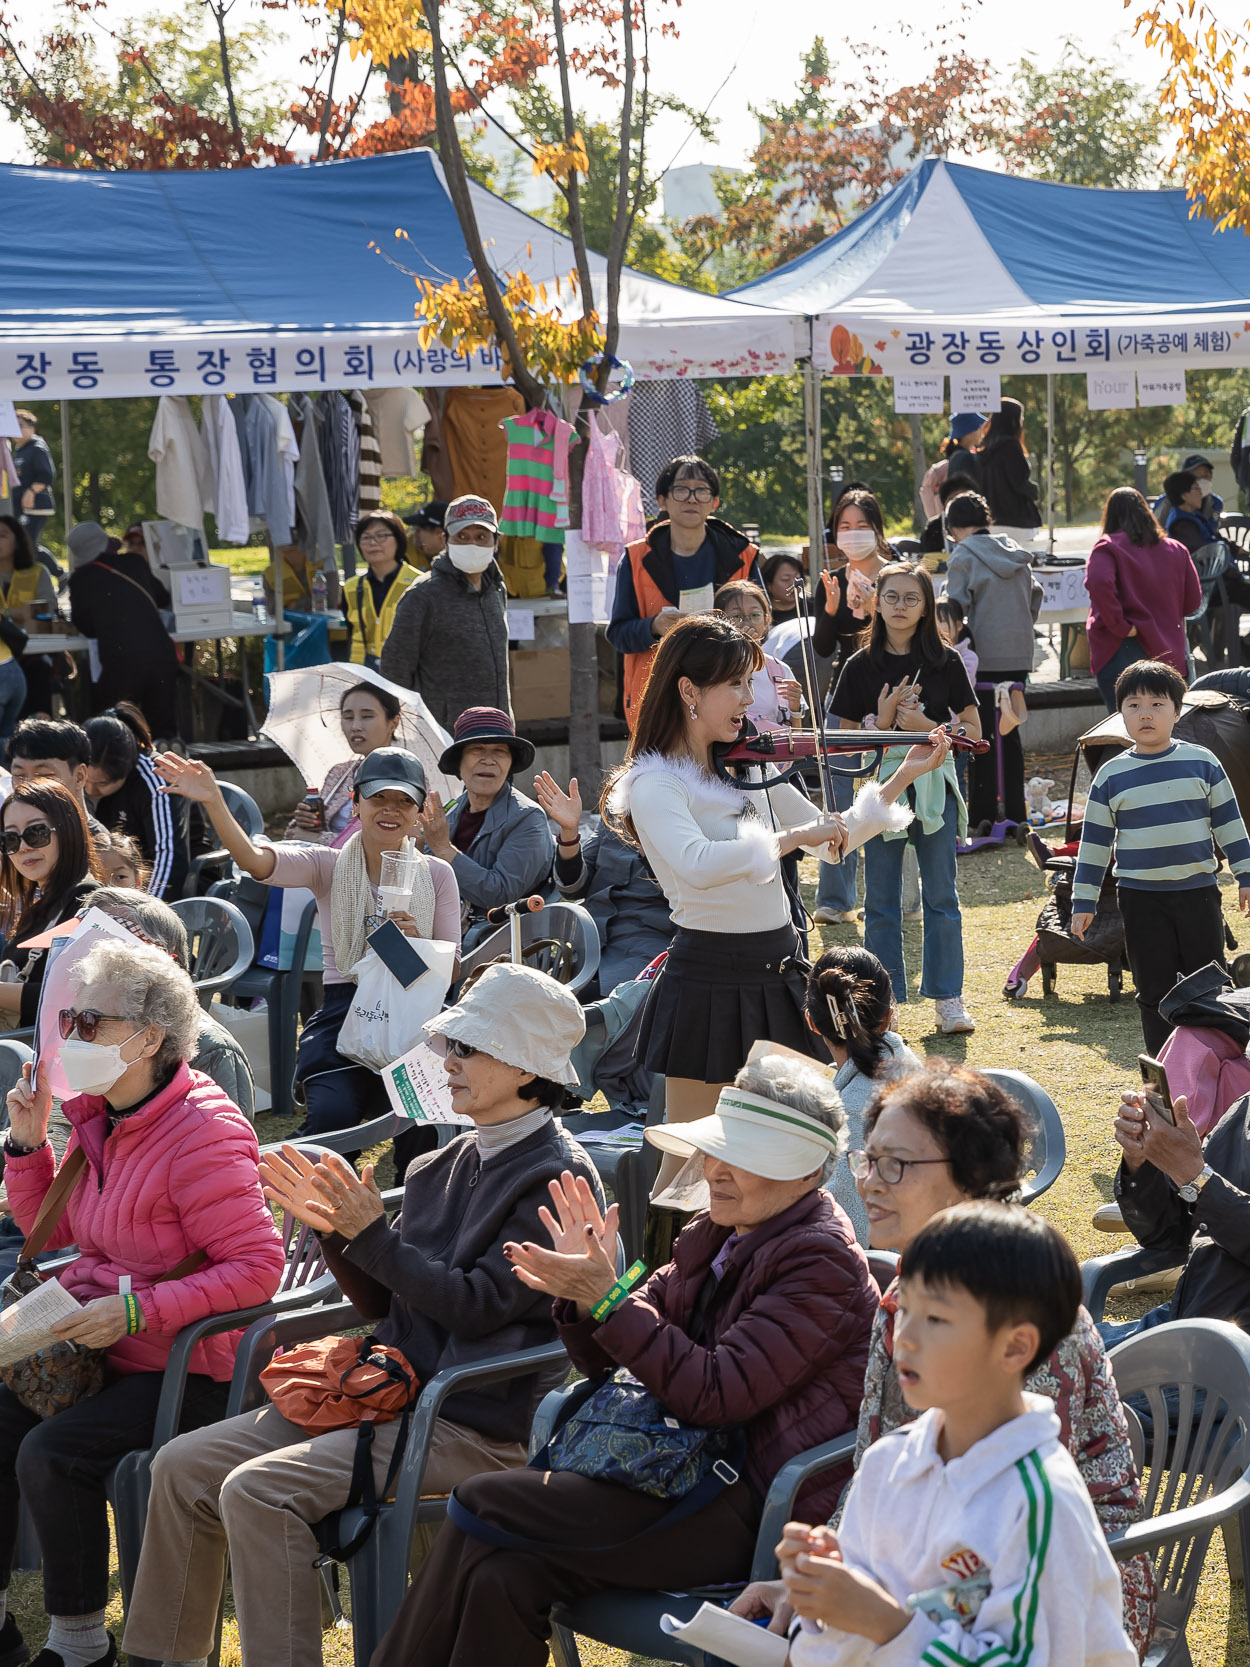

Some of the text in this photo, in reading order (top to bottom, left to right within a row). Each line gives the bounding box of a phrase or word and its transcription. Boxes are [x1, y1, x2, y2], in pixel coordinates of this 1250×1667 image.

[144, 345, 374, 388] 통장협의회
[905, 329, 1232, 365] 광장동 상인회 (가죽공예 체험)
